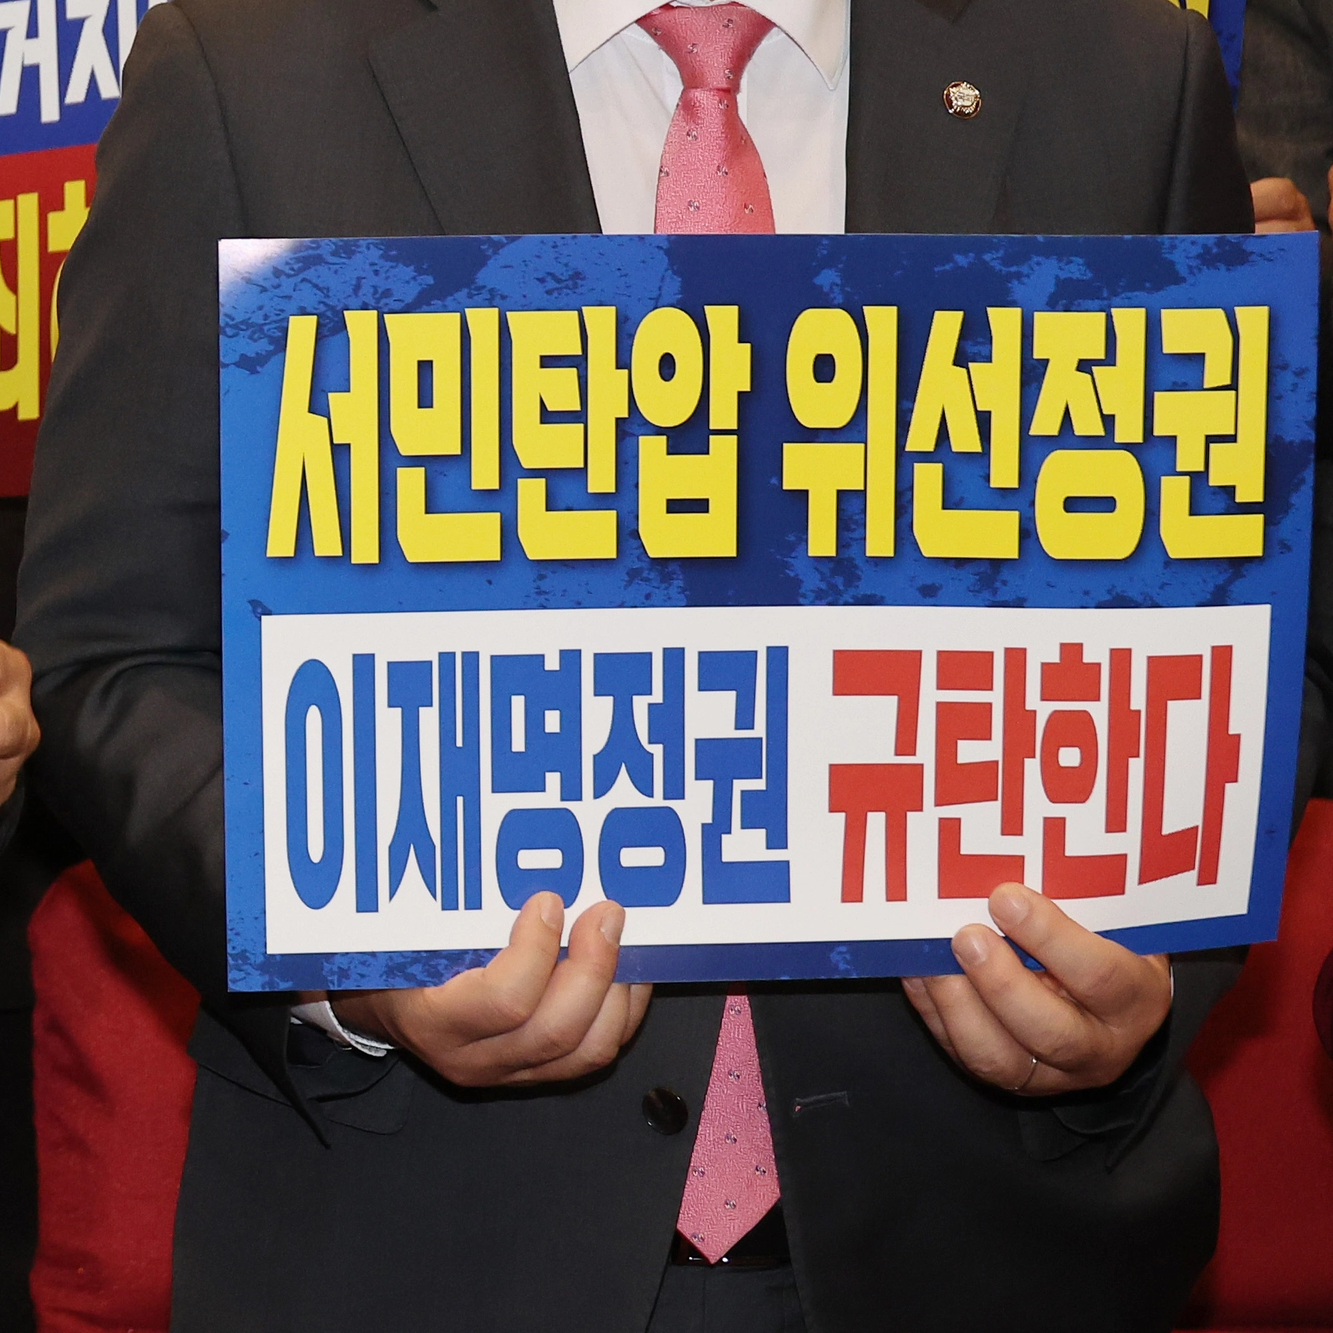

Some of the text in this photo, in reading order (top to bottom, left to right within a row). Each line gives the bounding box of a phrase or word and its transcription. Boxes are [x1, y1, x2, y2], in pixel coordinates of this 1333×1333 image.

[266, 304, 1270, 566] 서민탄압 위선정권
[284, 642, 1241, 914] 이재명정권 규탄한다
